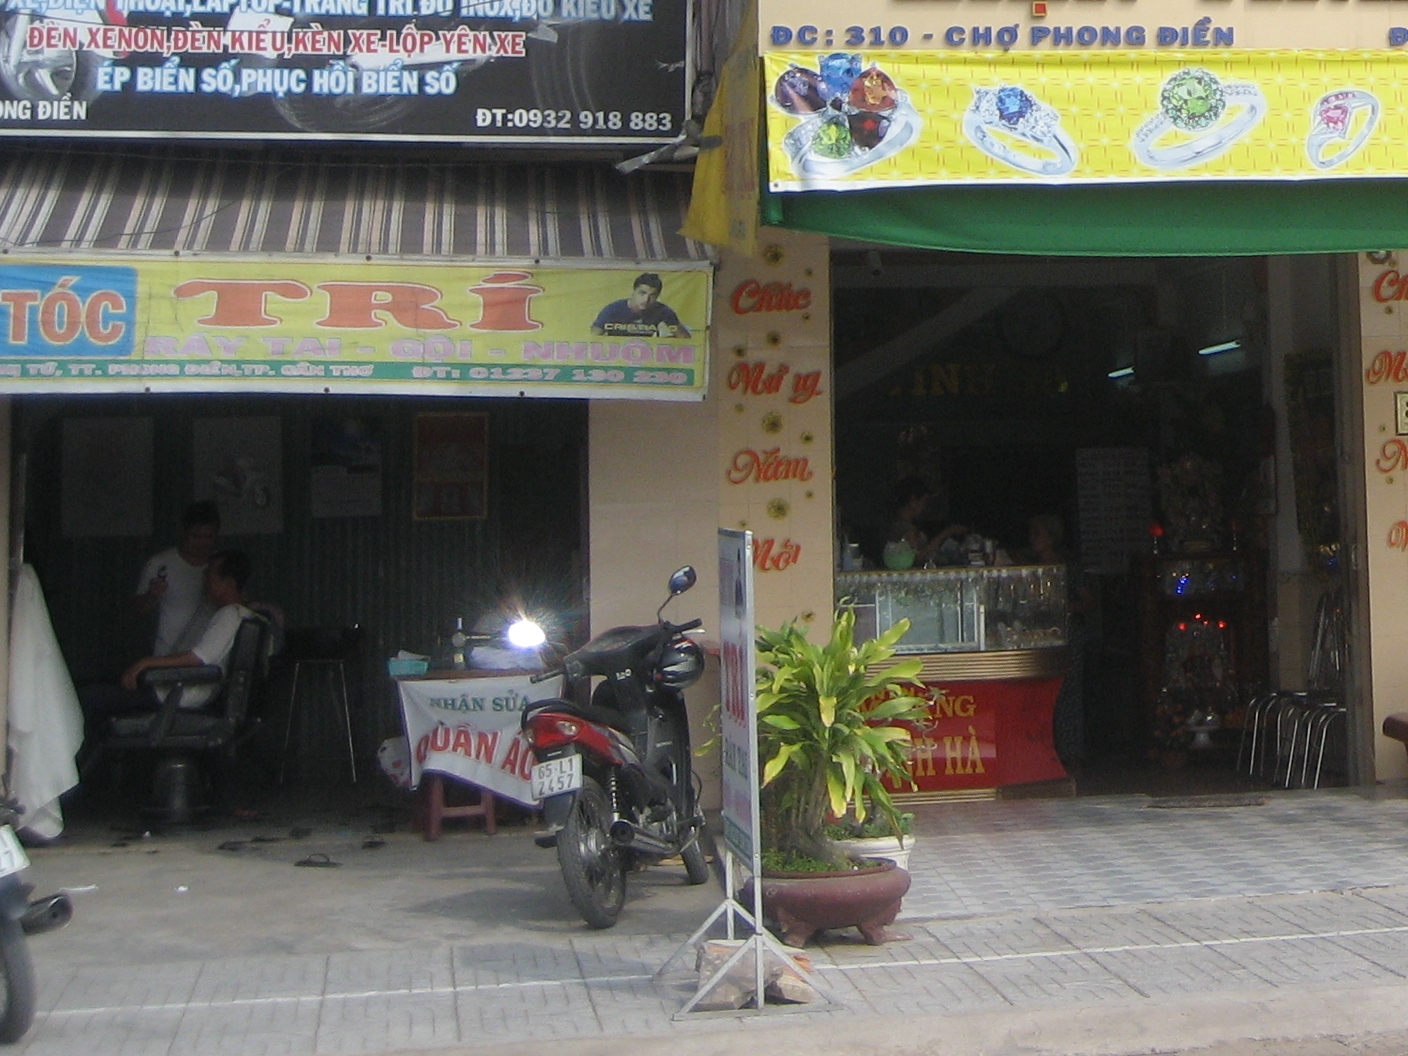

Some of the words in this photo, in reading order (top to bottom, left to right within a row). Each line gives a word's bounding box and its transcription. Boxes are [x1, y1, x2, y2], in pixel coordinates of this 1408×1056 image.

[495, 31, 526, 56] XE
[845, 25, 909, 46] 310
[944, 23, 1020, 52] CHỢ
[1030, 25, 1147, 46] PHONG
[38, 92, 87, 120] ĐIỀN
[579, 111, 622, 130] 918
[629, 112, 672, 132] 883
[0, 274, 128, 345] TÓC
[145, 331, 247, 357] RÁY
[262, 336, 341, 357] TAI
[390, 334, 474, 364] GỘI
[521, 338, 695, 368] NHUỘM
